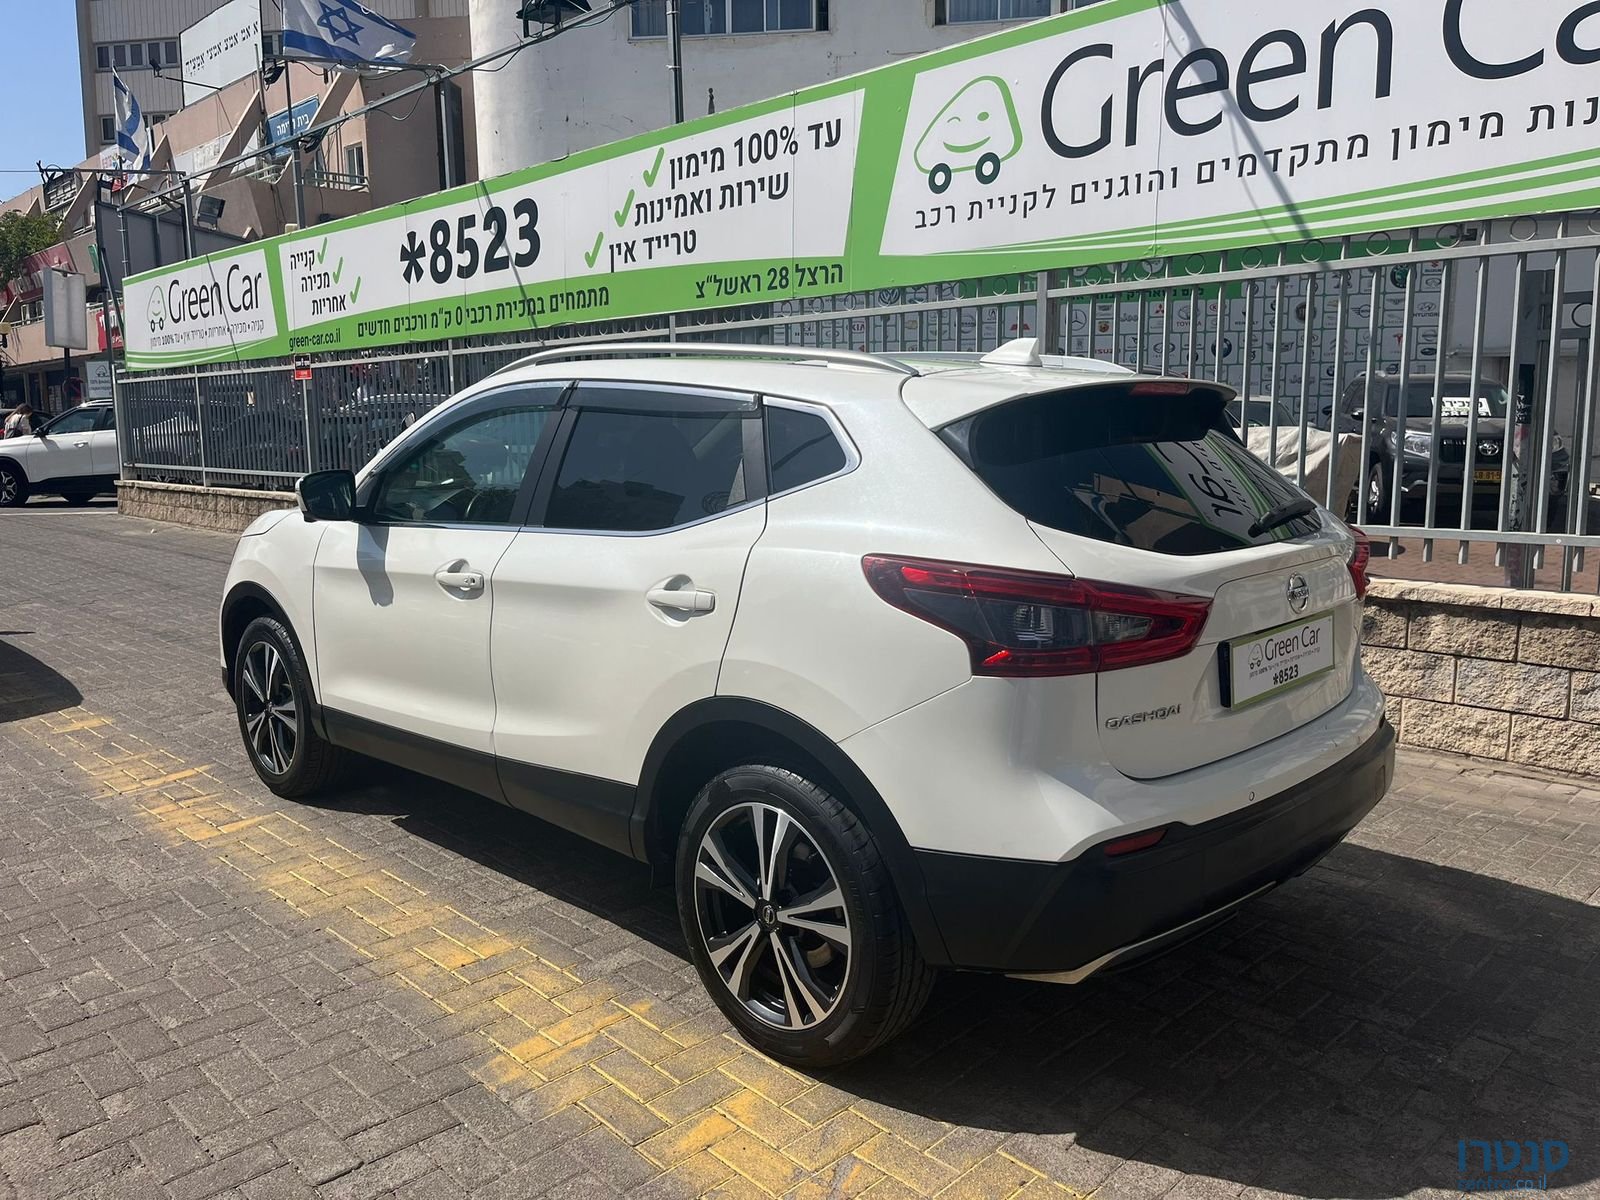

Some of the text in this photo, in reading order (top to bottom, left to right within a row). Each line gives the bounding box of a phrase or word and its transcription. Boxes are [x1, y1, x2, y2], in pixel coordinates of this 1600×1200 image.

[1041, 8, 1393, 158] Green
[296, 114, 310, 130] בית
[1392, 111, 1504, 161] מימון
[669, 118, 842, 190] עד 100% מימון
[1197, 134, 1369, 184] מתקדמים
[1071, 166, 1178, 205] והוגנים
[634, 172, 789, 227] שירות ואמינות
[967, 183, 1056, 221] לקניית
[914, 205, 956, 229] רכב
[290, 250, 315, 270] קנייה
[608, 229, 697, 274] טרייד אין
[301, 271, 330, 292] מכירה
[767, 266, 790, 290] 28
[794, 263, 843, 288] הרצל
[168, 264, 262, 324] Green Car
[311, 294, 348, 316] אחריות
[550, 286, 609, 313] מתמחים
[456, 304, 463, 326] 0
[466, 304, 492, 324] רכבי
[495, 296, 546, 320] במכירת
[357, 316, 391, 338] חדשים
[393, 312, 427, 333] ורכבים
[288, 328, 341, 352] green-car.co.il
[1264, 634, 1299, 661] Green
[1302, 626, 1320, 648] Car
[1105, 703, 1182, 730] QASHQAI
